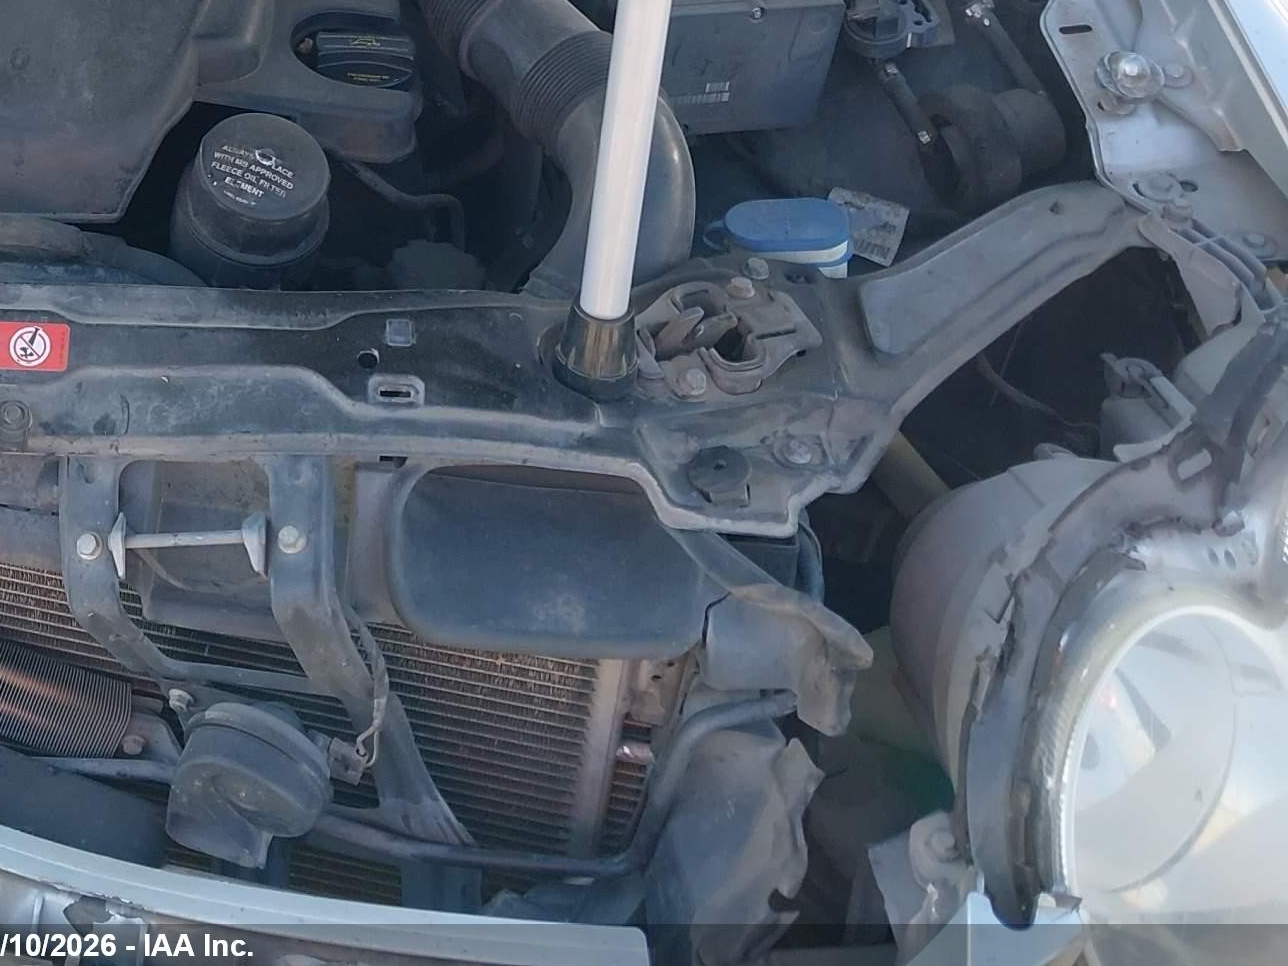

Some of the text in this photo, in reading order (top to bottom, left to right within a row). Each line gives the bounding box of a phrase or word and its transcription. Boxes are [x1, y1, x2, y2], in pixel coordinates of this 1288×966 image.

[211, 161, 244, 177] FLEECE
[244, 172, 257, 184] OIL
[258, 179, 287, 198] FILTER
[214, 151, 235, 163] WITH
[249, 164, 294, 190] APPROVED
